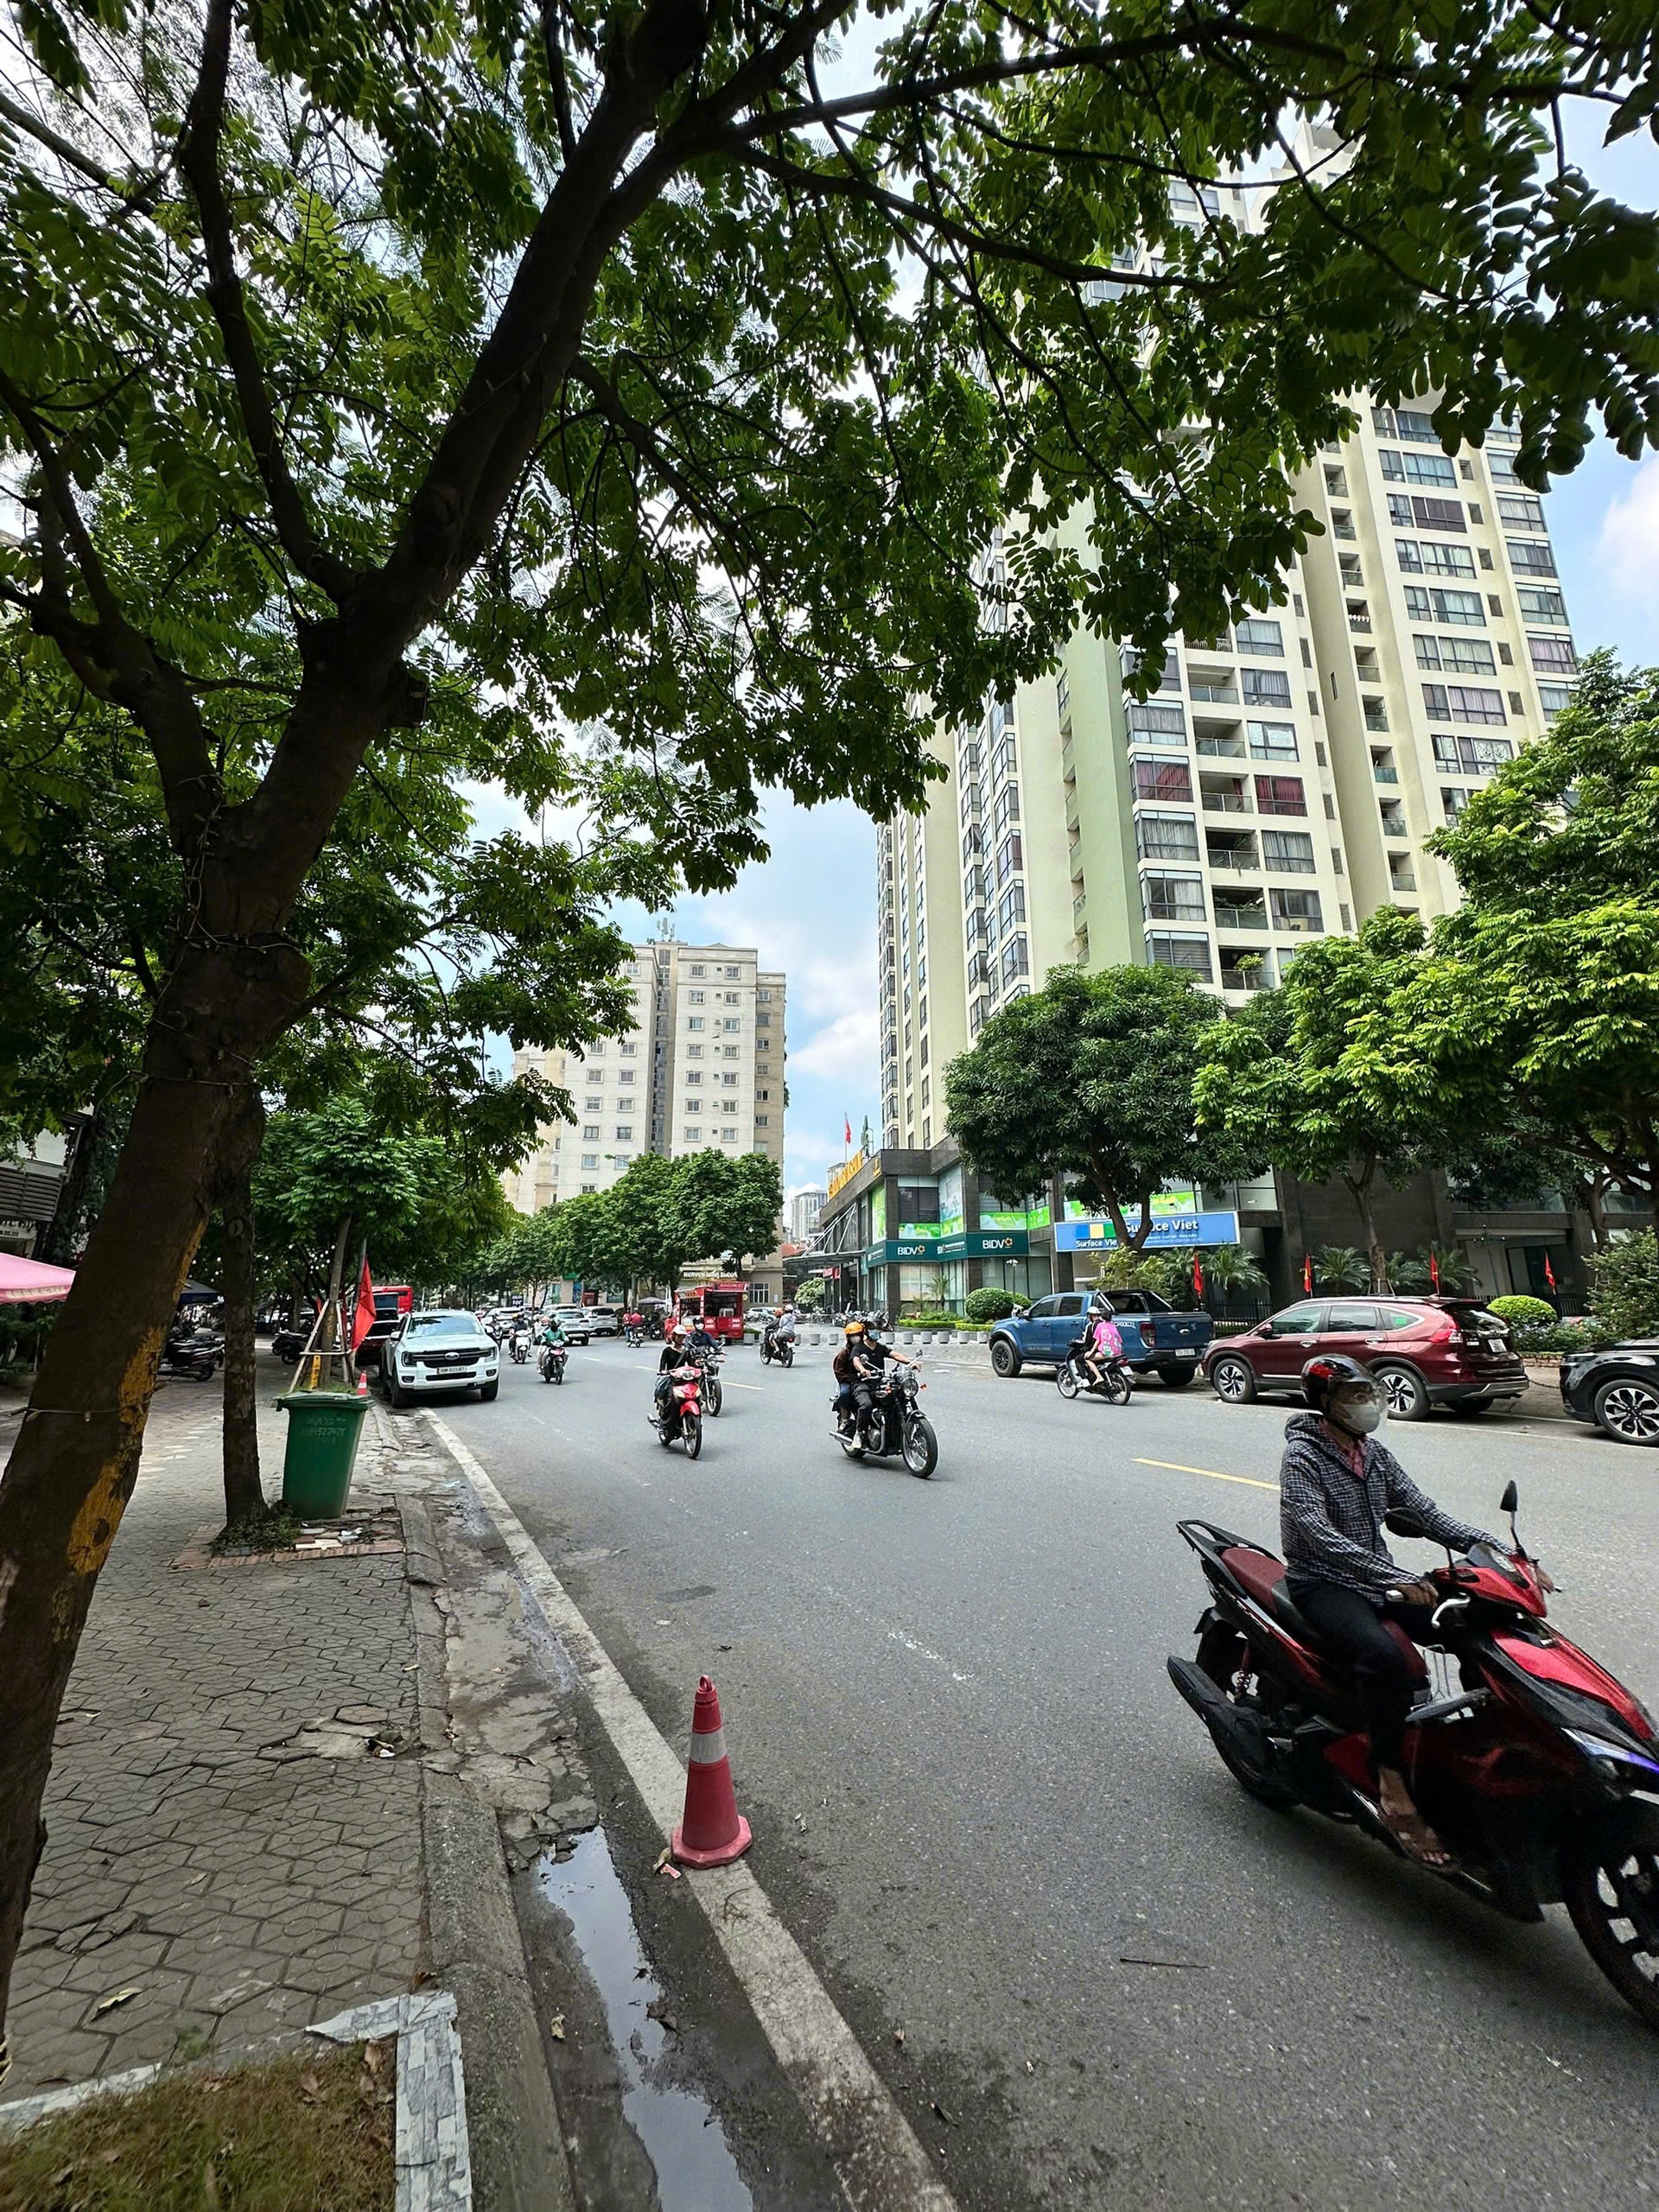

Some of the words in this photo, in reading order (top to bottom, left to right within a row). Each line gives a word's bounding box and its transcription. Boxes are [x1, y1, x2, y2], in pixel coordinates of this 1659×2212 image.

[1172, 1219, 1198, 1231] Viet
[982, 1239, 1005, 1249] BIDV
[1076, 1239, 1103, 1248] Surface
[897, 1246, 918, 1255] BIDV
